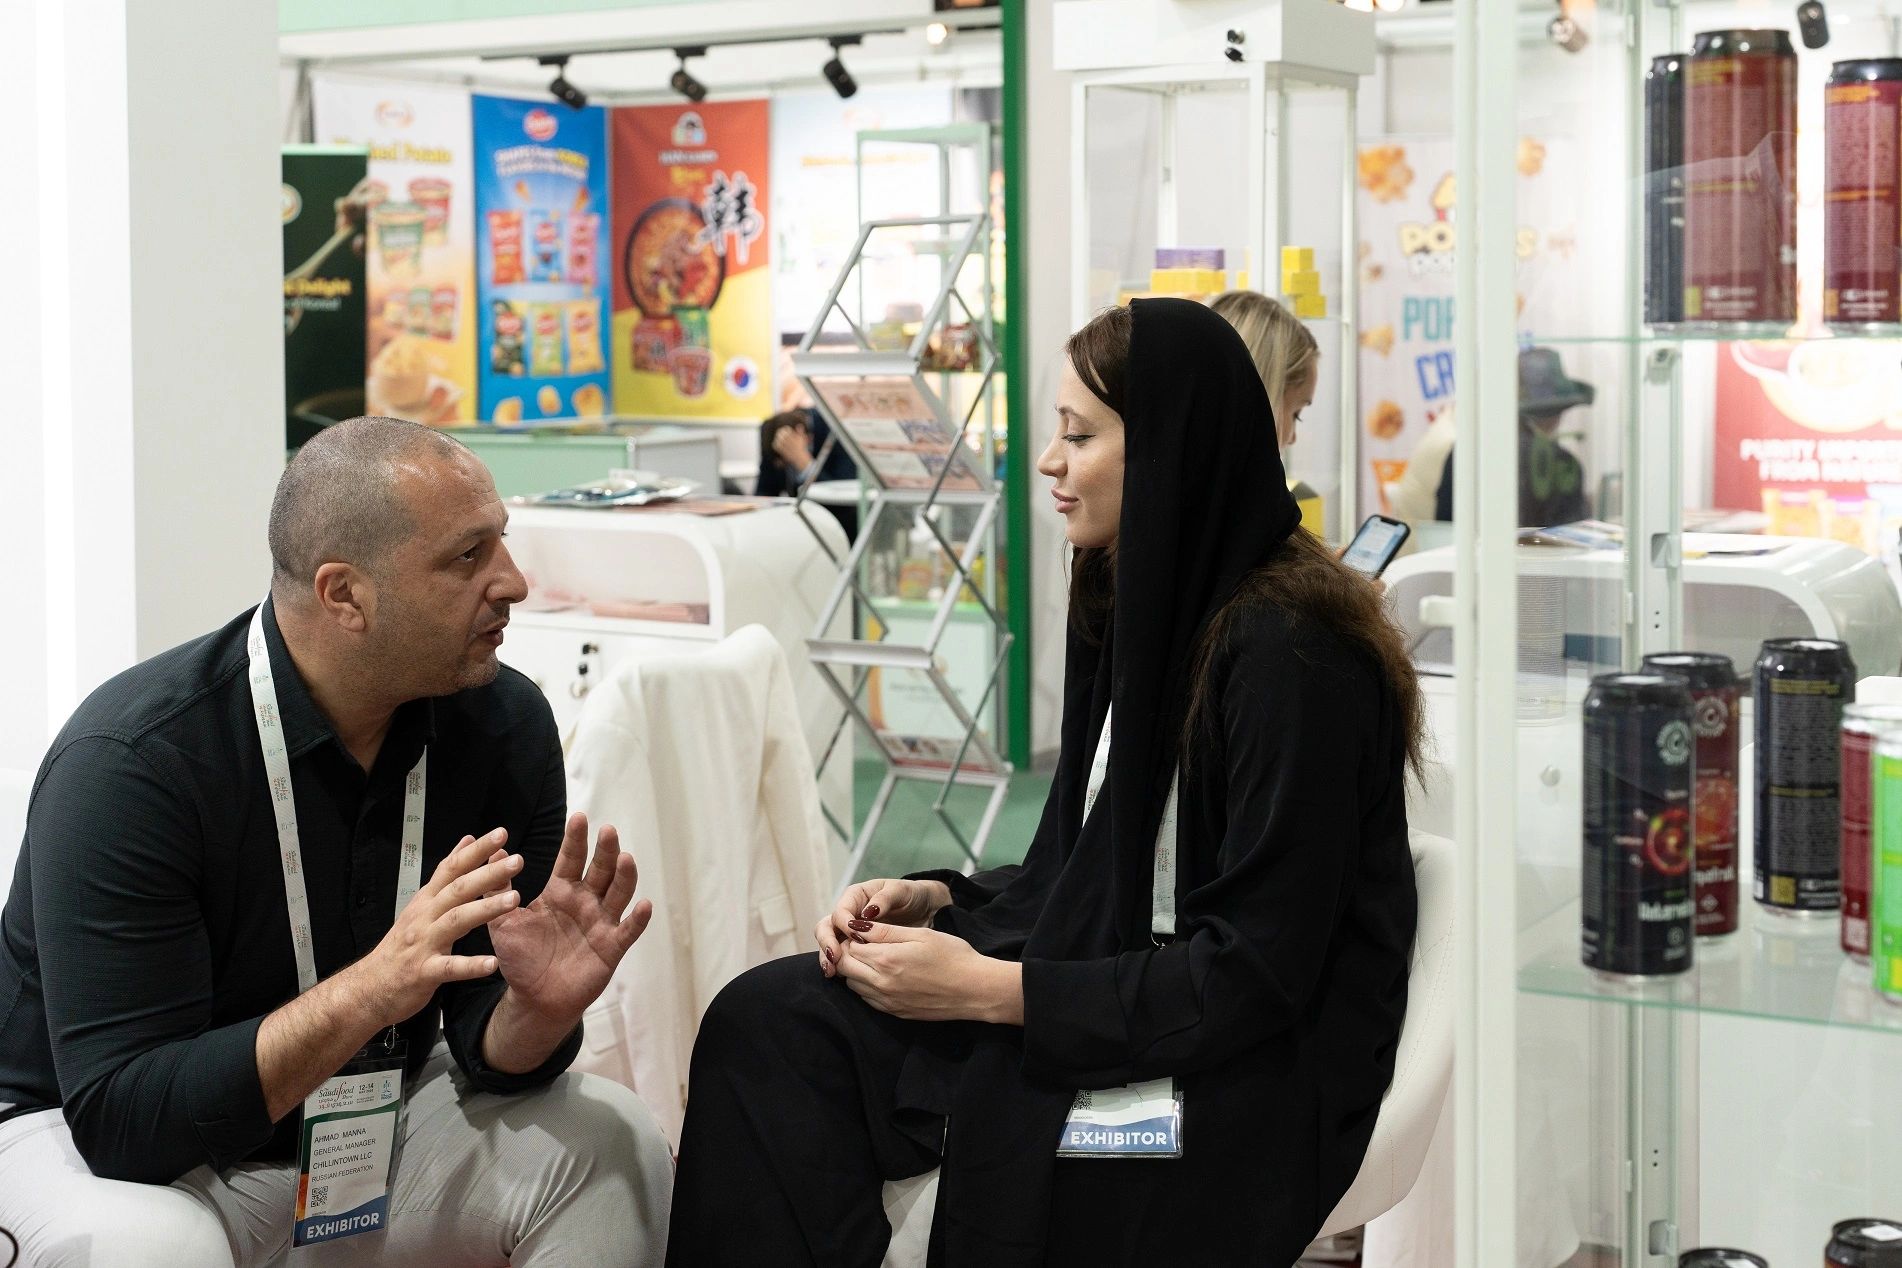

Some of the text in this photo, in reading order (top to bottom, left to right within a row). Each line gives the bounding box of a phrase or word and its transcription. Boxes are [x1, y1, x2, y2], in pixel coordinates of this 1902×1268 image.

[313, 1128, 367, 1143] AHMAD MANNA
[1070, 1131, 1167, 1145] EXHIBITOR
[313, 1138, 376, 1156] GENERAL MANAGER
[312, 1151, 373, 1170] CHILLINTOWN LLC
[311, 1164, 374, 1183] RUSSIAN FEDERATION
[306, 1212, 380, 1239] EXHIBITOR
